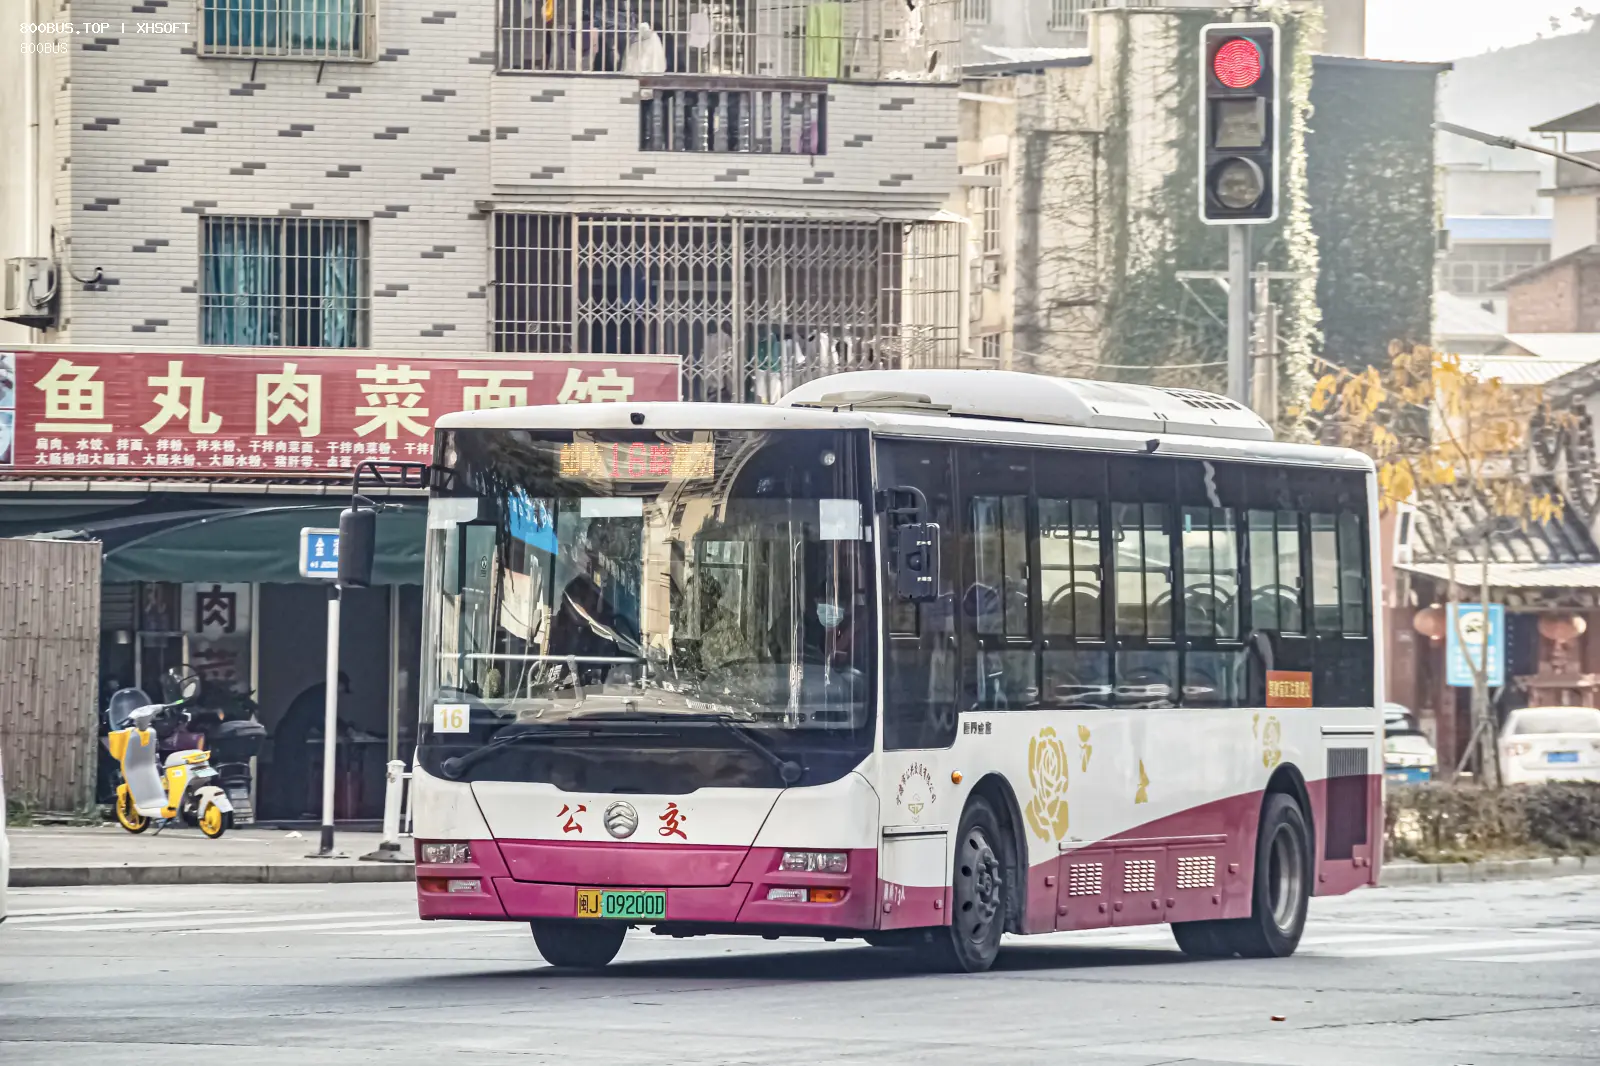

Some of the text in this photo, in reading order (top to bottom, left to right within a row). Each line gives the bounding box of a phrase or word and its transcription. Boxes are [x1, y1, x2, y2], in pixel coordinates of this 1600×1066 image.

[439, 708, 463, 729] 16
[556, 801, 688, 841] 公 交
[579, 894, 665, 915] 闽J 09200D
